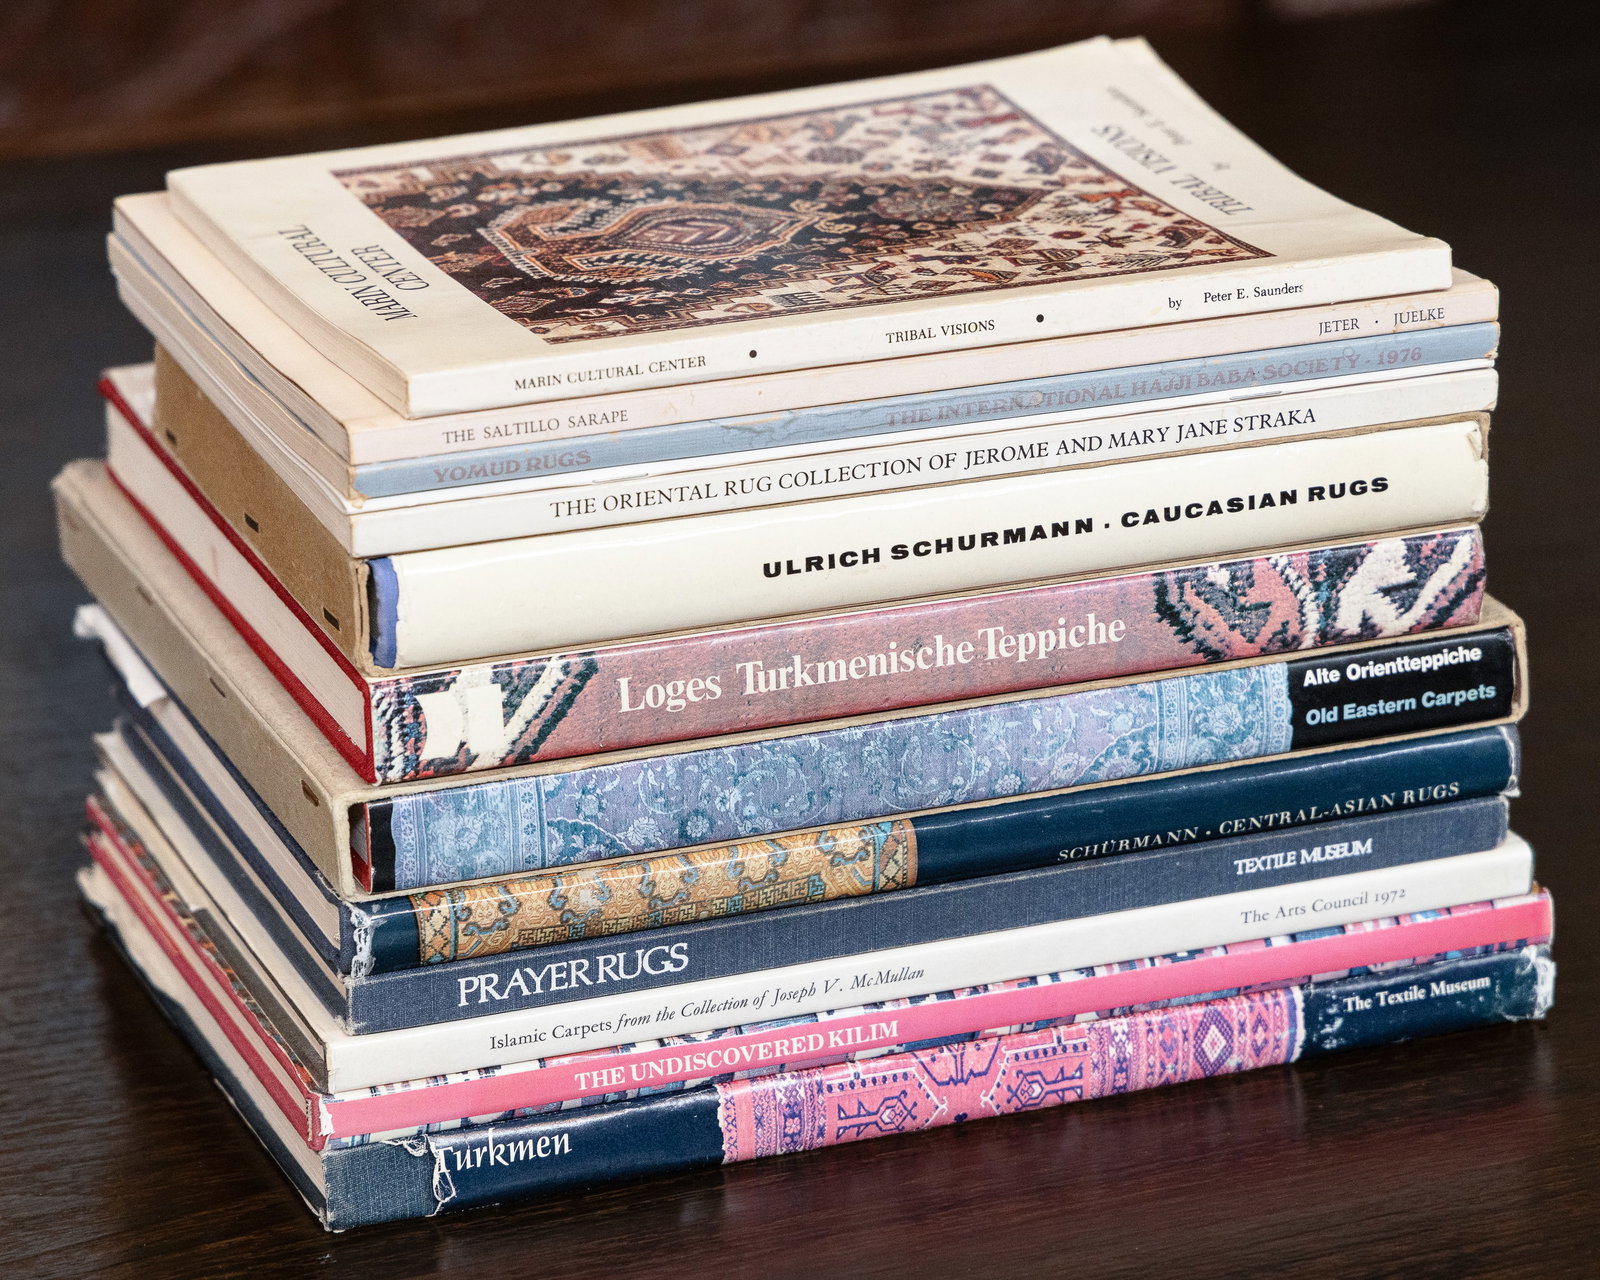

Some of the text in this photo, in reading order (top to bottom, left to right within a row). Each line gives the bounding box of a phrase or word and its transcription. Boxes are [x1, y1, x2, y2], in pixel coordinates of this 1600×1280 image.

[278, 223, 418, 321] MARIN CULTURAL
[350, 244, 430, 291] CENTER
[1168, 298, 1182, 309] by
[1203, 290, 1233, 304] Peter
[1236, 288, 1250, 300] E.
[885, 319, 996, 344] TRIBAL VISIONS
[1318, 307, 1445, 337] JETER JUELKE
[515, 355, 707, 391] MARIN CULTURAL CENTER
[887, 408, 933, 427] THE
[937, 383, 1127, 419] INTERNTIONAL
[1131, 374, 1192, 396] HAJJI
[1197, 367, 1258, 388] BABA
[1262, 352, 1362, 382] SOCIETY
[1377, 347, 1423, 366] 1976
[442, 409, 629, 445] THE SALTILLO SARAPE
[433, 449, 592, 484] YOMUD RUGS
[550, 407, 1317, 519] THE ORIENTAL RUG COLLECTION OF JEROME AND MARY JANE STRAKA
[763, 476, 1390, 578] ULRICH SCHURMANN CAUCASIAN RUGS
[617, 612, 1127, 714] Loges Turkmenische Teppiche
[1303, 646, 1484, 688] Alte Orientteppiche
[1305, 683, 1498, 726] Old Eastern Carpets
[1057, 781, 1461, 862] SCHÜRMANN CENTRAL-ASIAN RUGS
[1234, 837, 1374, 875] TEXTILE MUSEUM
[1240, 887, 1407, 924] The Arts Council 1972
[457, 942, 690, 1007] PRAYER RUGS
[1342, 976, 1492, 1013] The Textile Museum
[489, 966, 926, 1050] Islamic Carpets from the Collection of Joseph V. McMullan
[574, 1019, 899, 1092] THE UNDISCOVERED KILIM
[435, 1126, 573, 1174] Turkmen
